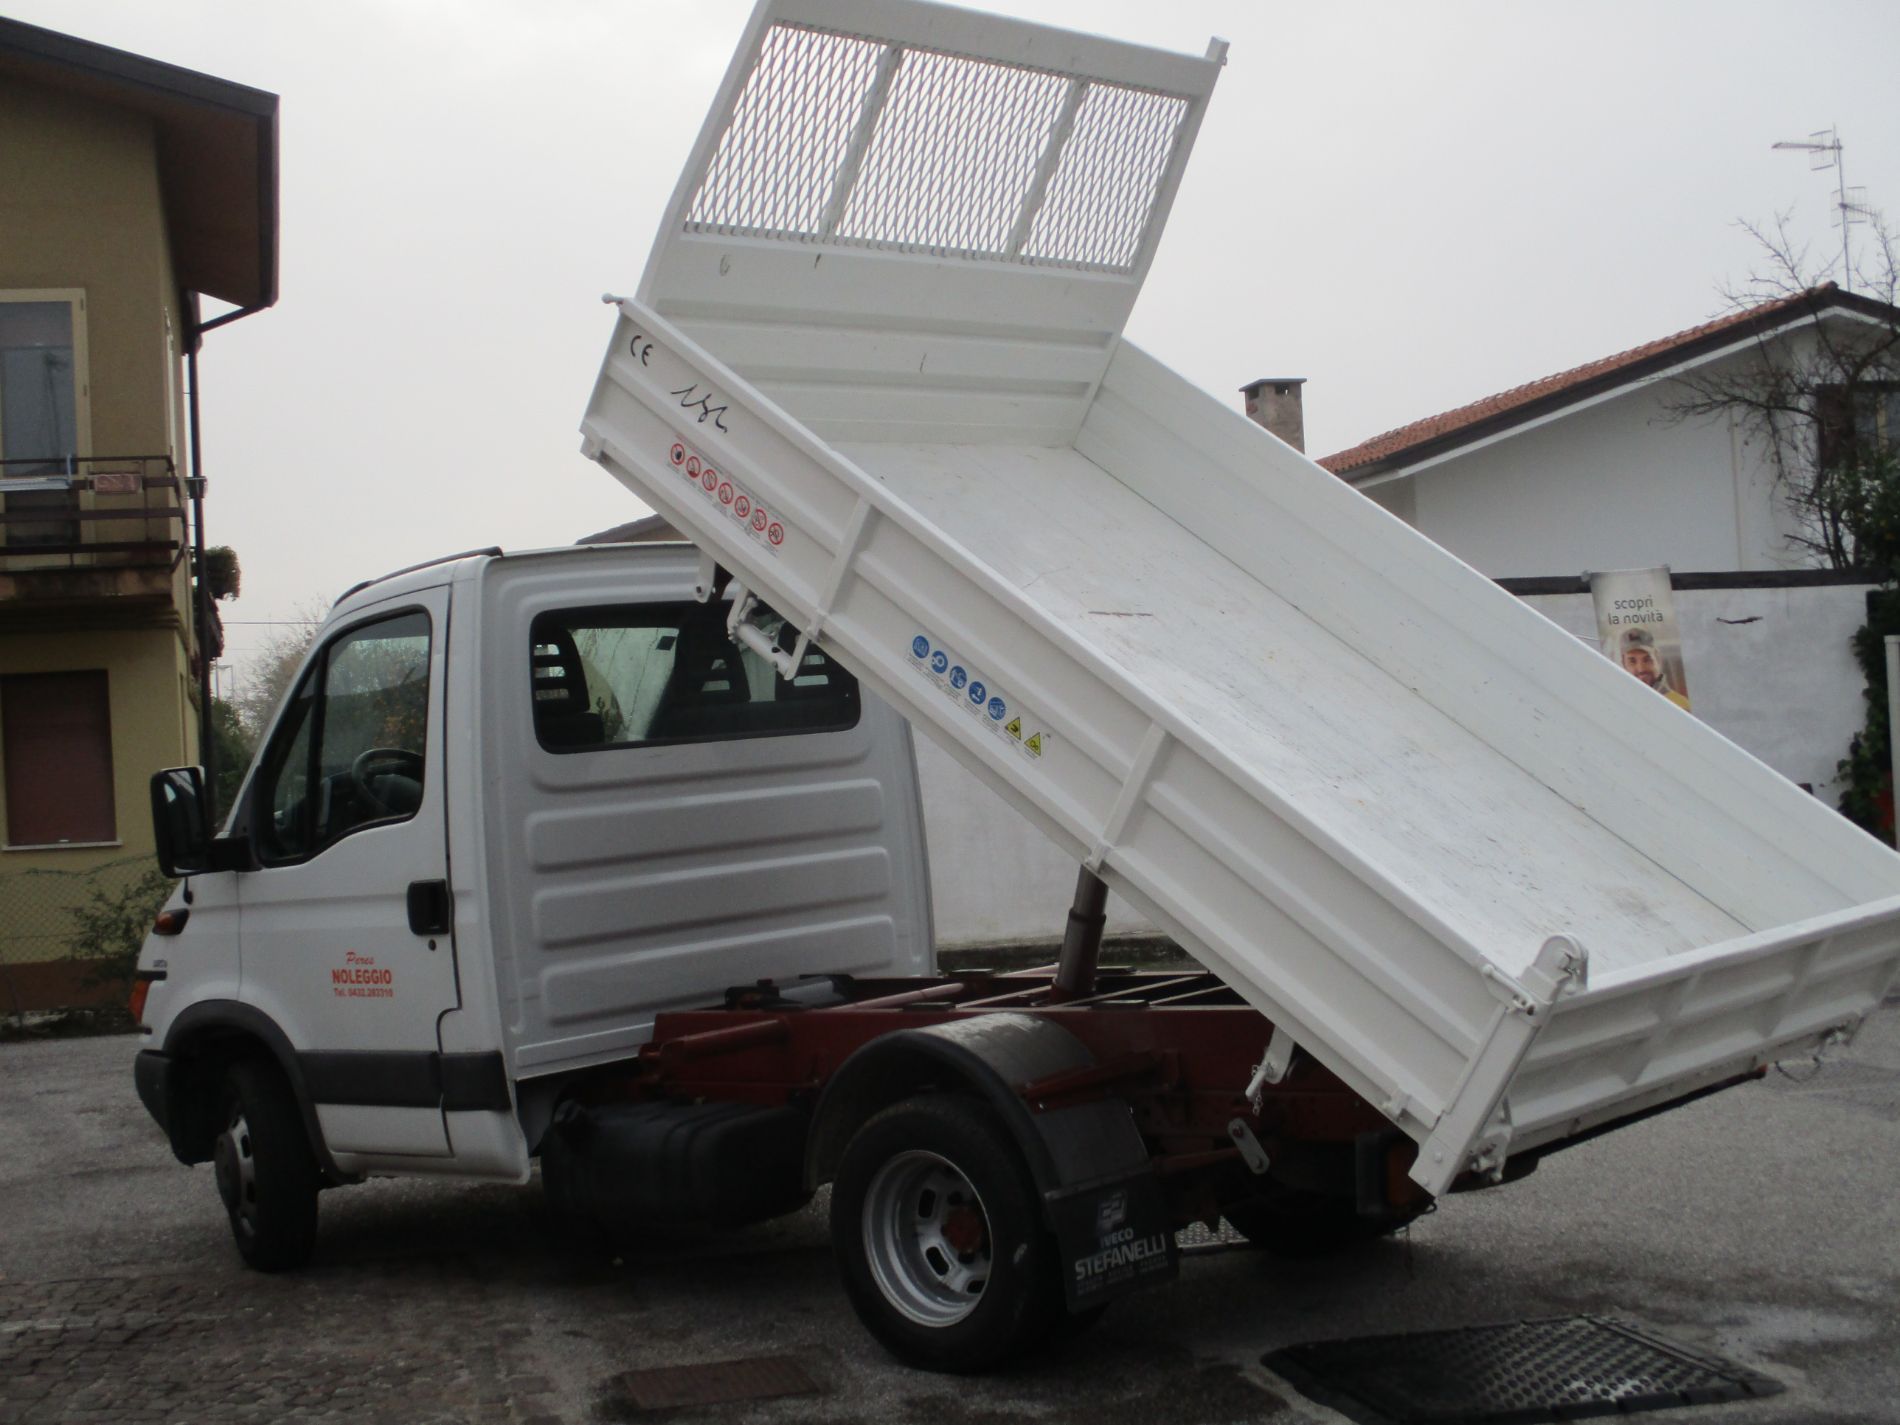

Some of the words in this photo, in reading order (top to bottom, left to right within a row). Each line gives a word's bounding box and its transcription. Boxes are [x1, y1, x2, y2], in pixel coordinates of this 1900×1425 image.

[630, 335, 653, 367] CE
[1614, 594, 1654, 611] scopri
[1608, 613, 1620, 625] la
[1623, 609, 1664, 624] novità
[332, 969, 393, 985] NOLEGGIO
[1100, 1227, 1135, 1248] IVECO
[1074, 1232, 1167, 1281] STEFANELLI
